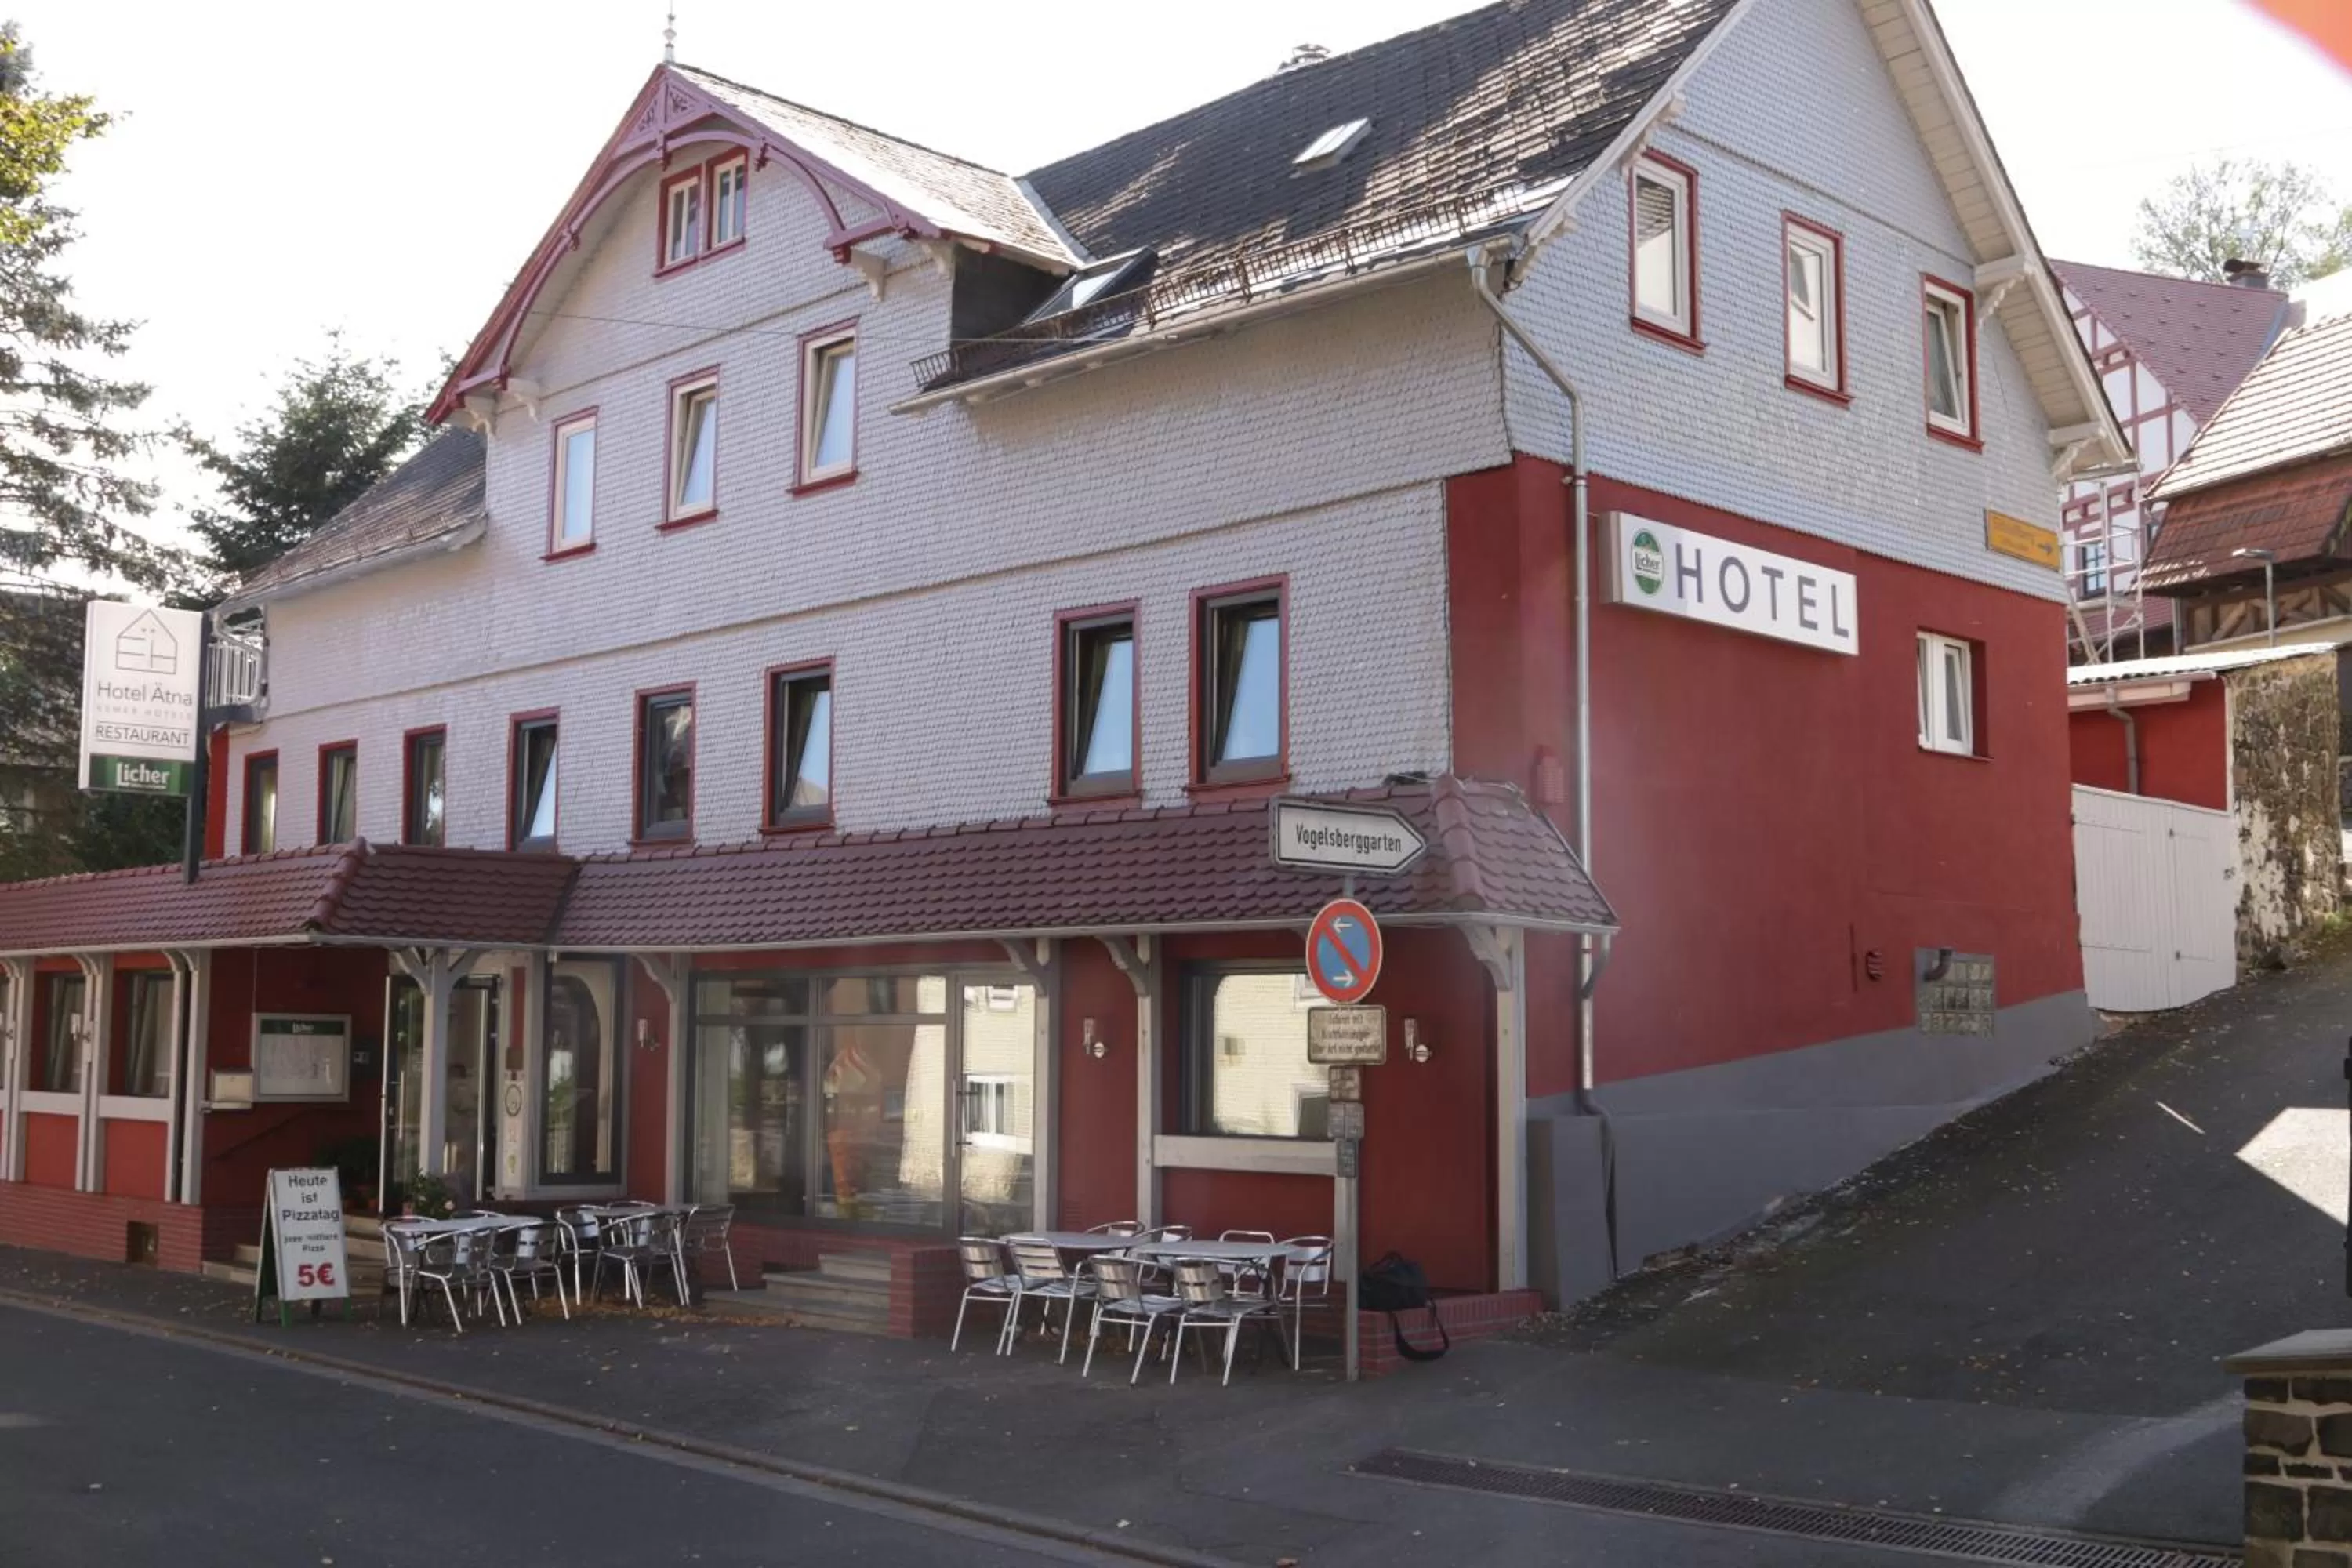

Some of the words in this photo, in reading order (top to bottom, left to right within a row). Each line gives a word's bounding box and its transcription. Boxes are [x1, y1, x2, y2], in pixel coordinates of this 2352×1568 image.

[1675, 543, 1849, 639] HOTEL
[97, 681, 147, 702] Hotel
[151, 681, 193, 707] Ätna
[96, 724, 189, 745] RESTAURANT
[116, 761, 170, 786] Licher
[1296, 823, 1402, 854] Vogelsberggarten
[288, 1175, 328, 1188] Heute
[301, 1192, 318, 1203] ist
[282, 1209, 339, 1222] Pizzatag
[297, 1262, 336, 1287] 5€
